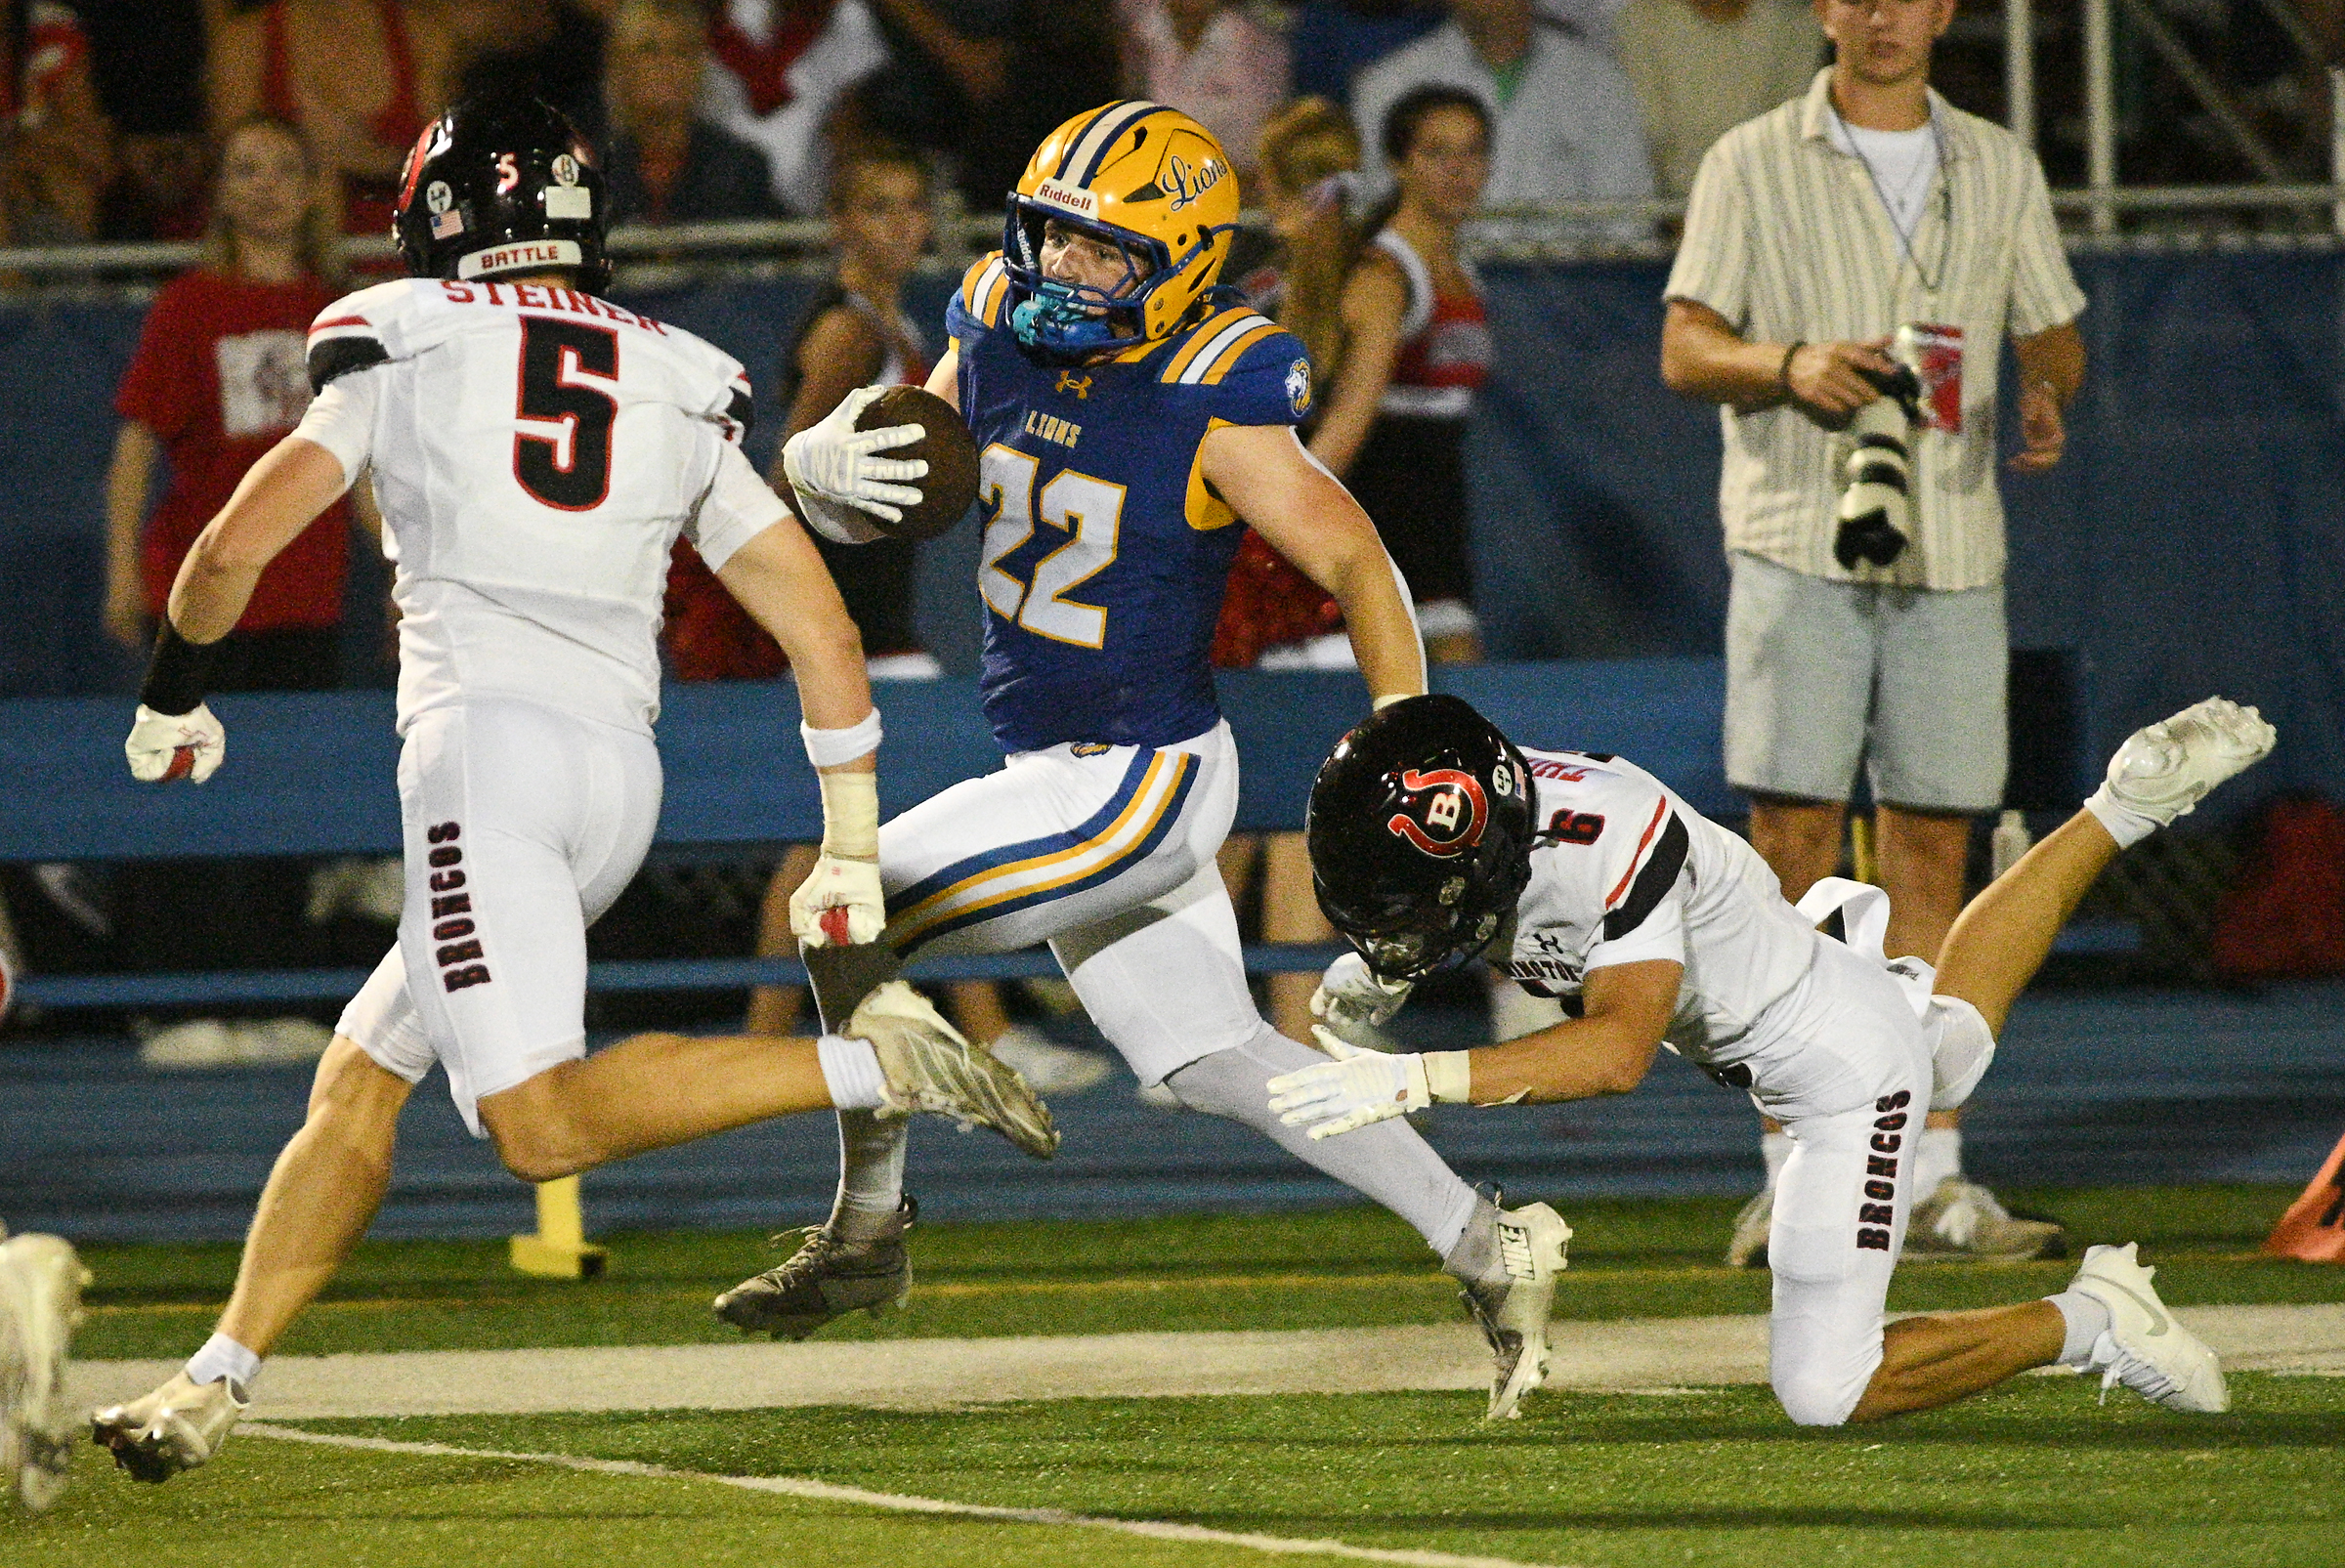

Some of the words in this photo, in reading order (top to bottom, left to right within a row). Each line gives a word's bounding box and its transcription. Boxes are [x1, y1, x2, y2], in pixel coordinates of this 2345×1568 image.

[1040, 184, 1092, 211] Riddell
[481, 245, 558, 270] BATTLE
[513, 314, 619, 512] 5
[1025, 410, 1082, 448] LIONS
[979, 442, 1128, 650] 22
[1427, 791, 1461, 831] B
[1549, 807, 1605, 846] 6
[427, 821, 492, 994] BRONCOS
[1856, 1089, 1911, 1252] BRONCOS
[1498, 1222, 1536, 1281] NIKE
